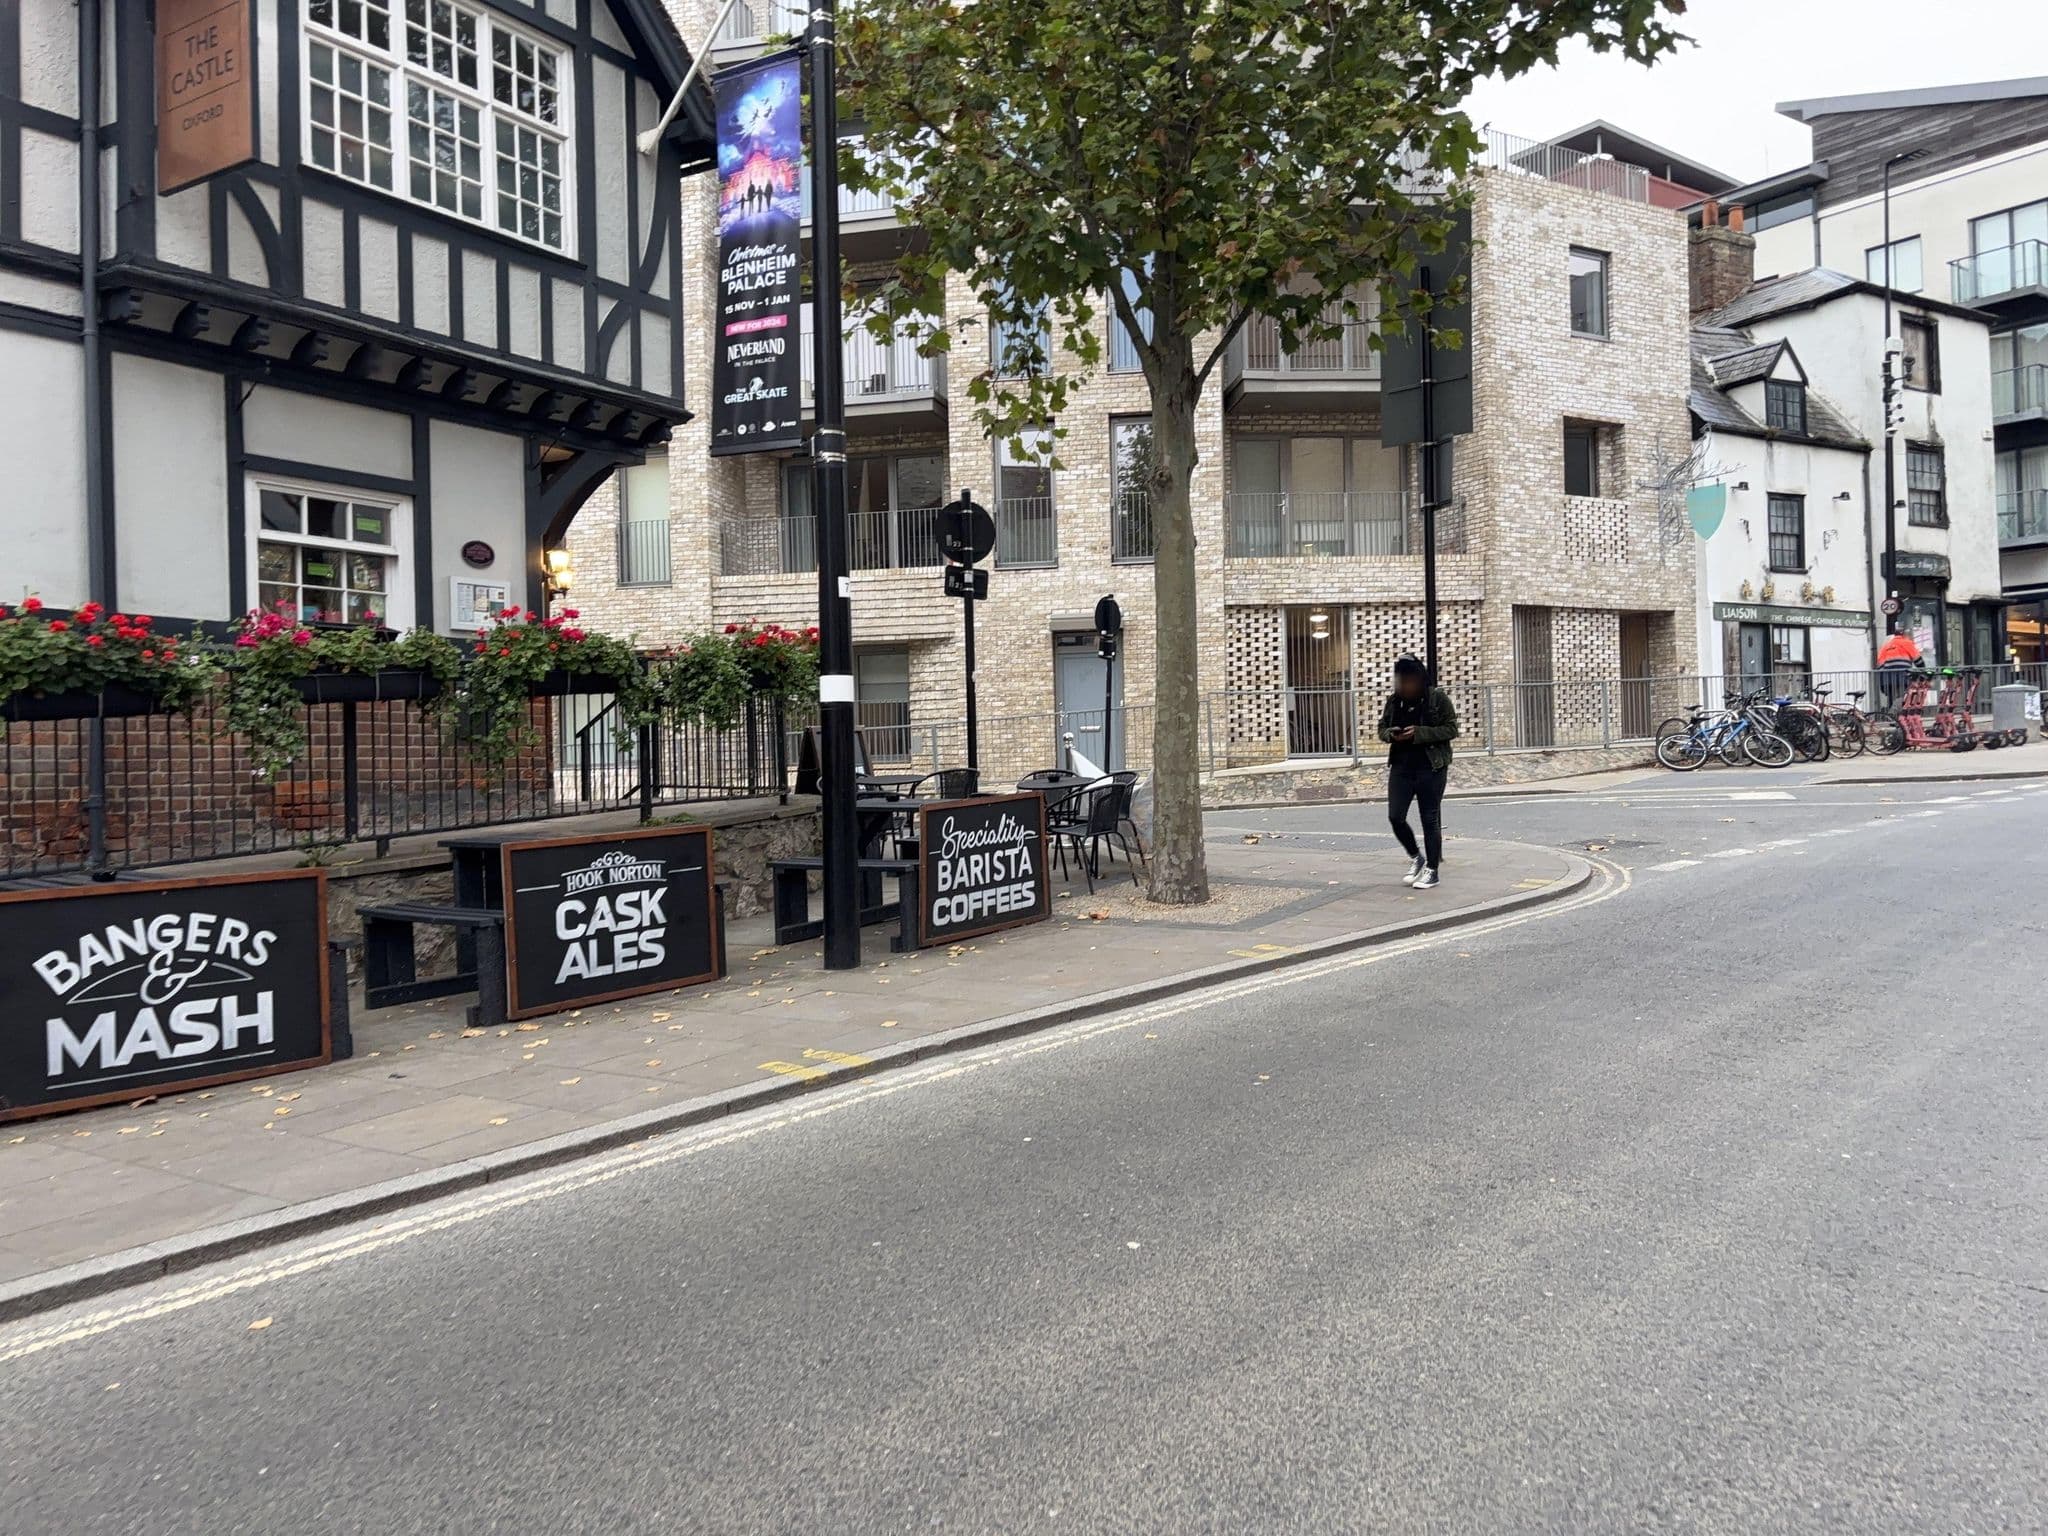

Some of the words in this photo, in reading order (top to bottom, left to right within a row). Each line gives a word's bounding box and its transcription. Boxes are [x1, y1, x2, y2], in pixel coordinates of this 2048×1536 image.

[184, 25, 218, 58] THE
[171, 48, 234, 95] CASTLE
[182, 103, 224, 131] OXFORD
[721, 252, 796, 283] BLENHEIM
[727, 243, 777, 265] Christmas
[727, 270, 787, 295] PALACE
[725, 304, 734, 315] 15
[734, 300, 755, 312] NOV
[764, 297, 769, 306] 1
[770, 294, 791, 305] JAN
[727, 337, 786, 363] NEVERLAND
[723, 390, 754, 405] GREAT
[755, 386, 788, 400] SKATE
[1721, 607, 1758, 619] LIAISON
[1883, 603, 1897, 611] 20
[941, 813, 1036, 859] Speciality
[566, 869, 605, 892] HOOK
[609, 863, 662, 882] NORTON
[937, 846, 1033, 892] BARISTA
[555, 886, 669, 941] CASK
[932, 880, 1036, 927] COFFEES
[31, 912, 278, 996] BANGERS
[554, 927, 666, 985] ALES
[140, 948, 209, 1005] &
[45, 990, 275, 1077] MASH
